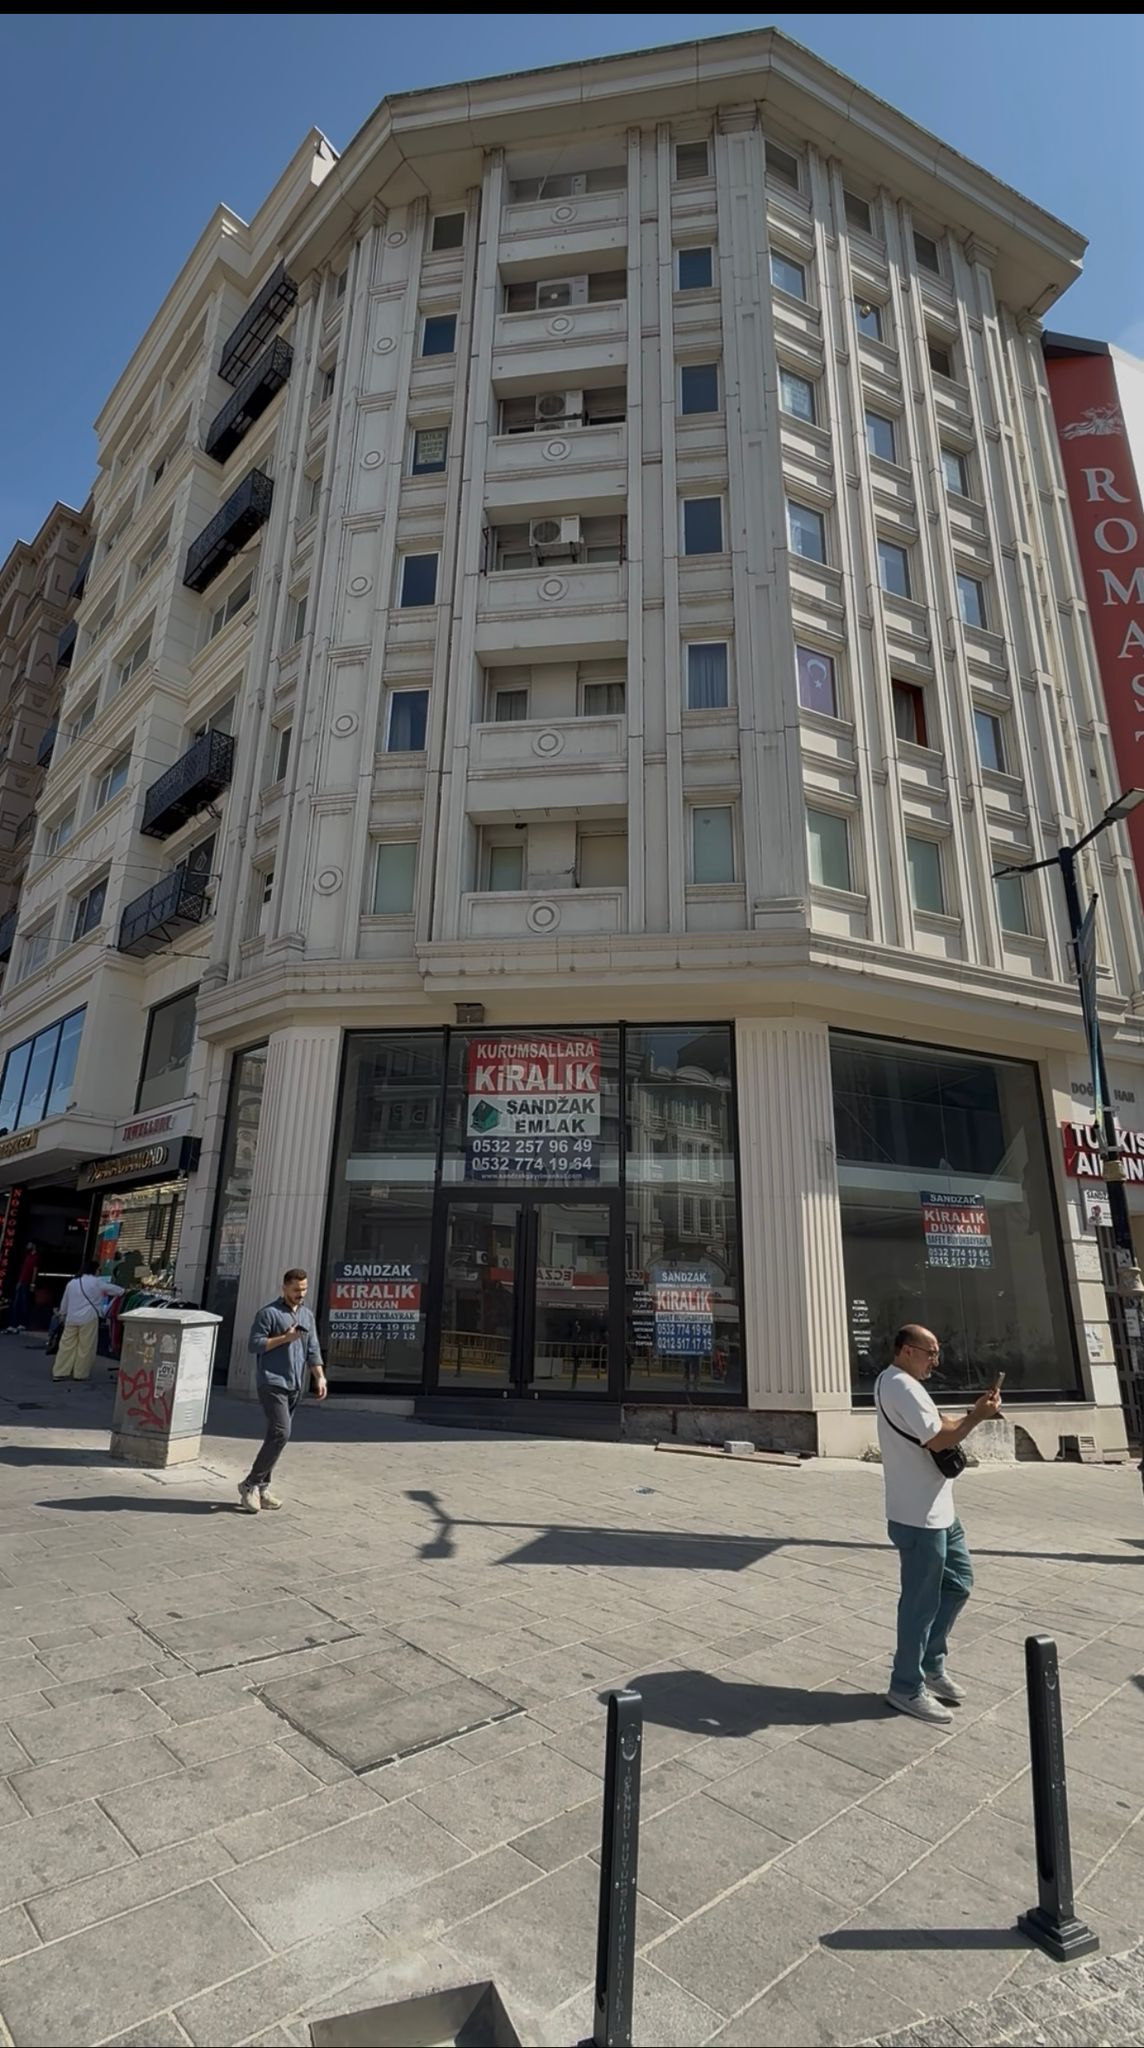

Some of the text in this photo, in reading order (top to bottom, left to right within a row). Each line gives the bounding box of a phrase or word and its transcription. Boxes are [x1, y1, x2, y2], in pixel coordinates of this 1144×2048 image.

[1080, 467, 1144, 742] ROMAS
[477, 1042, 595, 1058] KURUMSALLARA
[506, 1096, 596, 1115] SANDŽAK
[515, 1118, 585, 1133] EMLAK
[1071, 1123, 1144, 1155] TUKIS
[472, 1139, 592, 1153] 0532 257 96 49
[472, 1156, 592, 1171] 0532 774 19 64
[931, 1223, 981, 1234] DÜKKAN
[929, 1248, 989, 1257] 0532 774 19 64
[930, 1256, 990, 1266] 0212 517 17 15
[352, 1299, 399, 1309] DÜKKAN
[402, 1323, 416, 1331] 64
[657, 1323, 711, 1336] 0532 774 19 64
[386, 1332, 399, 1340] 17
[403, 1332, 416, 1340] 15
[657, 1337, 675, 1349] 0212
[676, 1337, 690, 1349] 517
[692, 1337, 701, 1349] 17
[703, 1338, 712, 1350] 15
